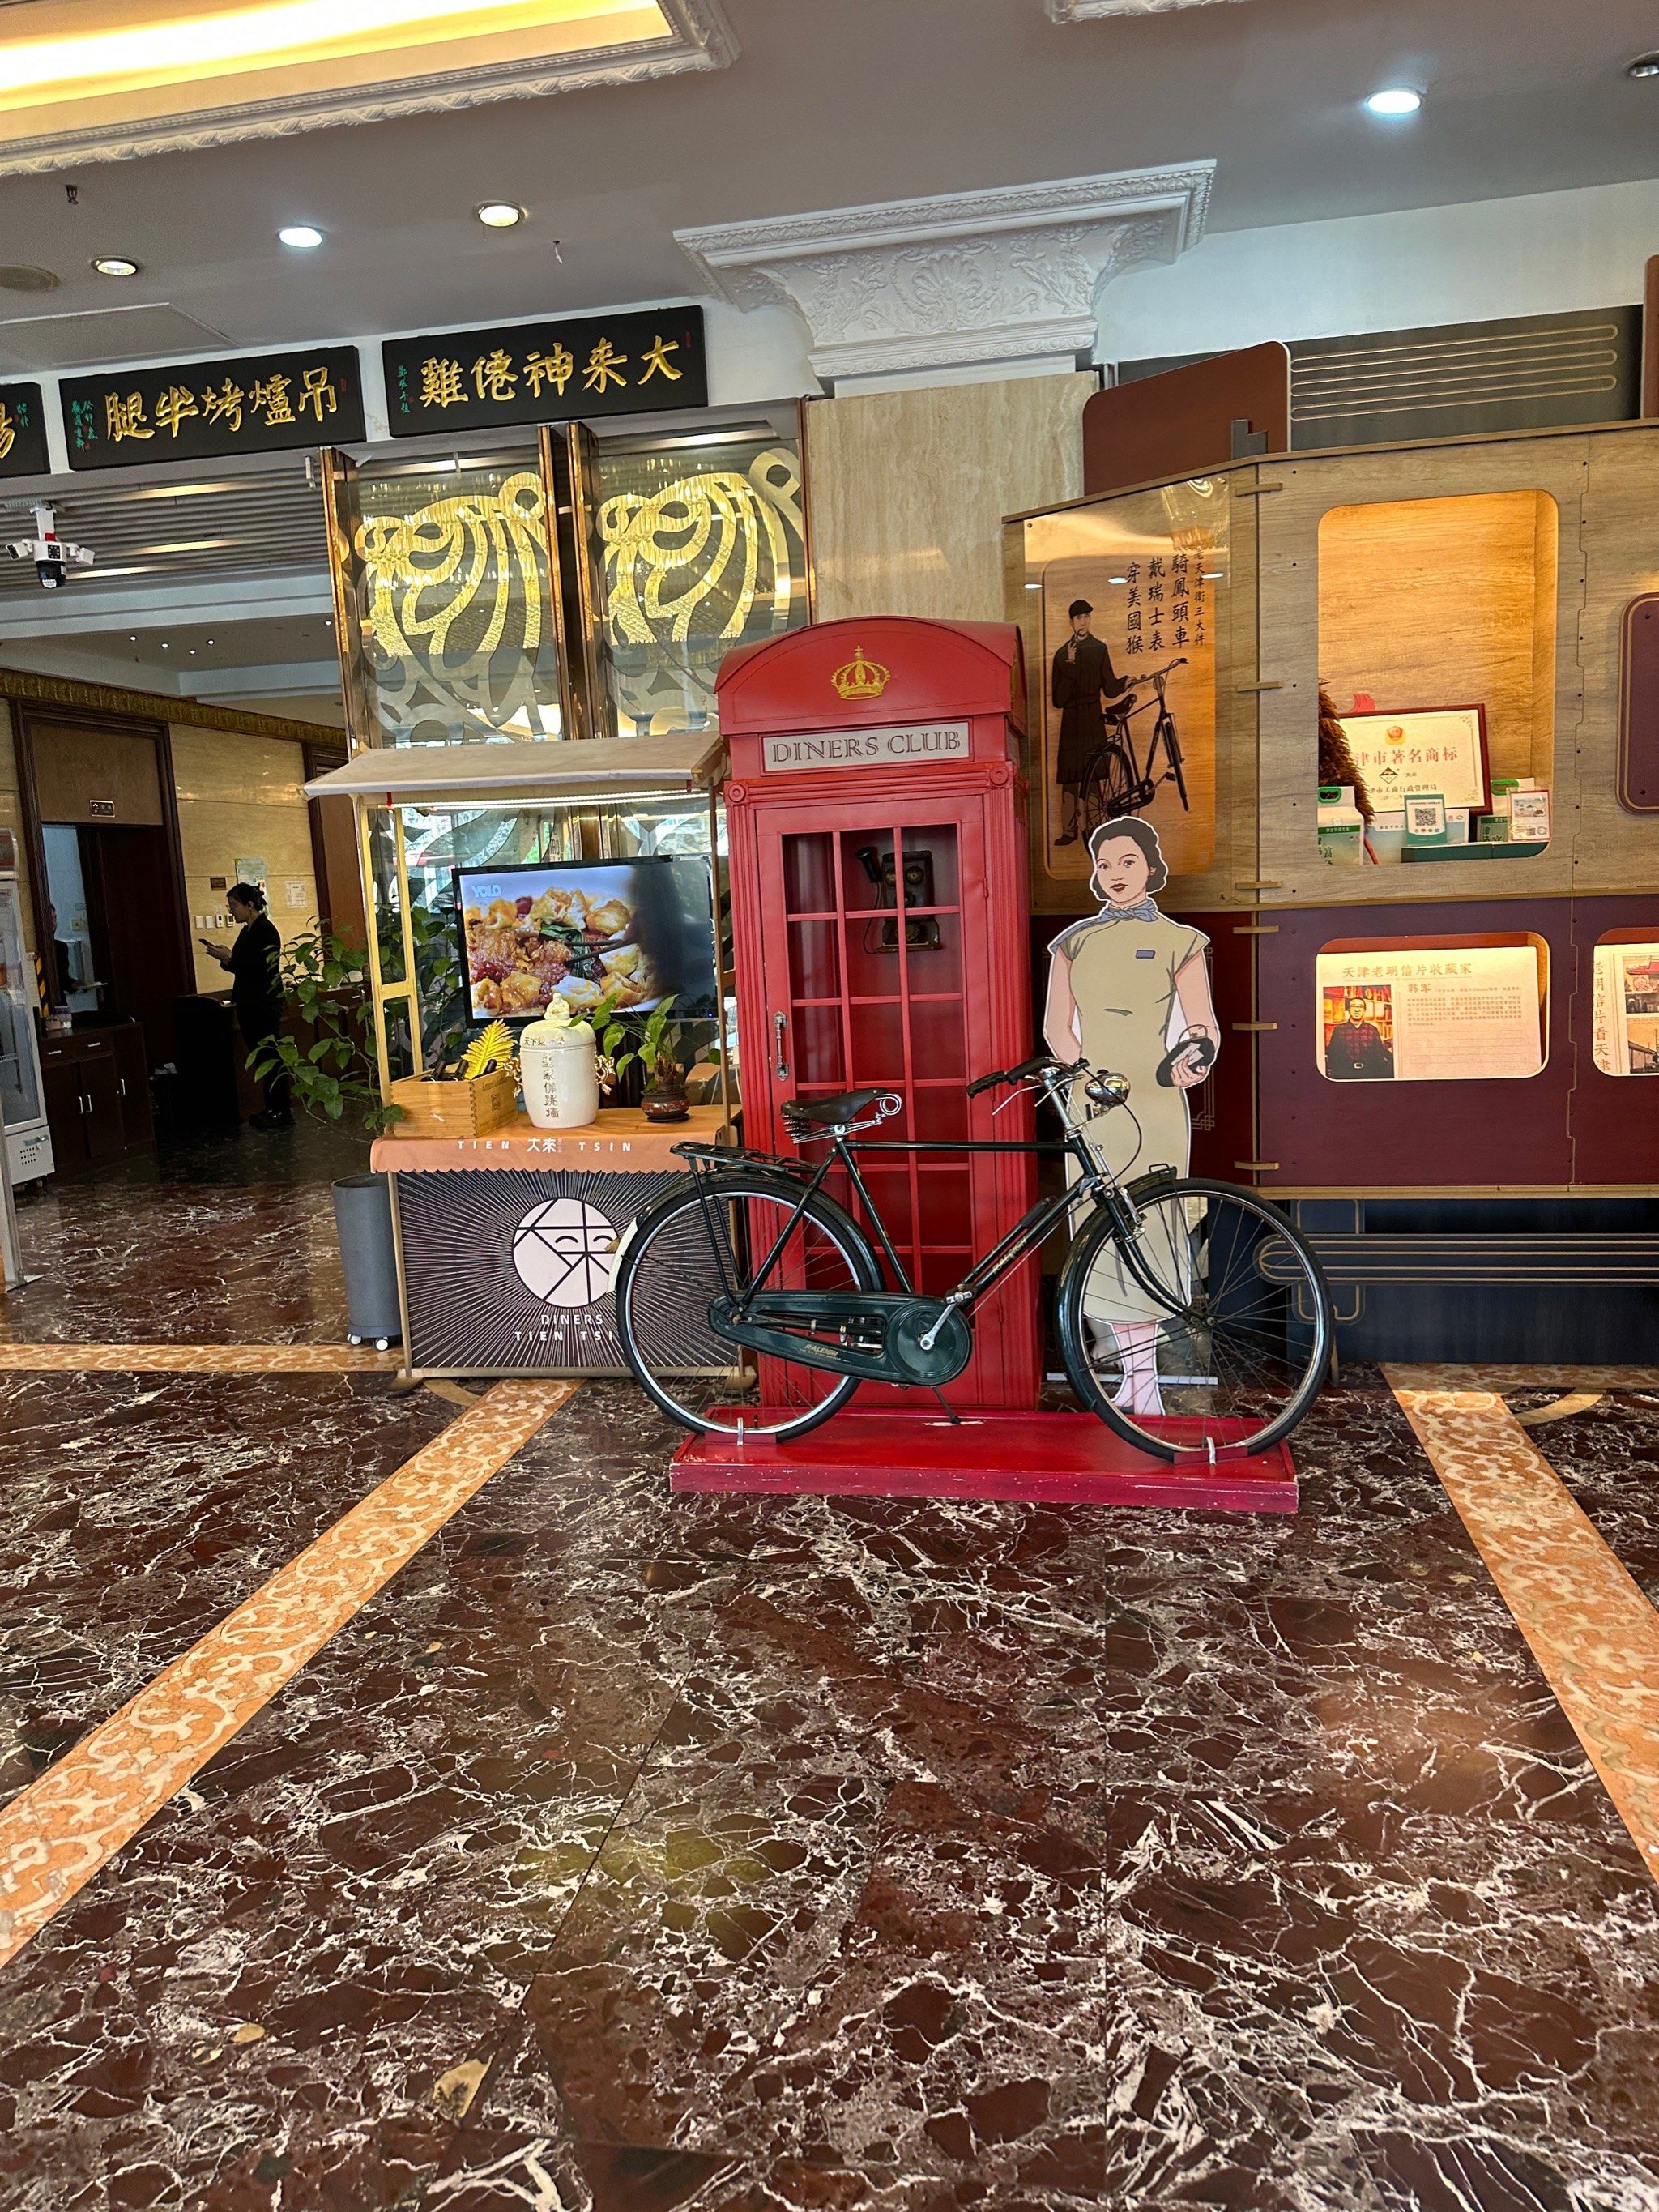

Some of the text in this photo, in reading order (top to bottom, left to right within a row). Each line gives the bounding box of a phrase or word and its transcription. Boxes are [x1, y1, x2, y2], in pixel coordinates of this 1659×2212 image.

[1148, 556, 1166, 651] 戴瑞士表
[1171, 553, 1190, 648] 騎鳳頭車
[772, 731, 961, 762] DINERS CLUB
[1355, 746, 1458, 767] 津市著名商标
[1369, 784, 1437, 794] 津市工商行政管理局
[471, 884, 502, 898] YOLO
[458, 1140, 510, 1150] TIEN
[579, 1142, 631, 1151] TSIN
[541, 1314, 603, 1325] DINERS
[514, 1330, 613, 1341] TIEN TSI
